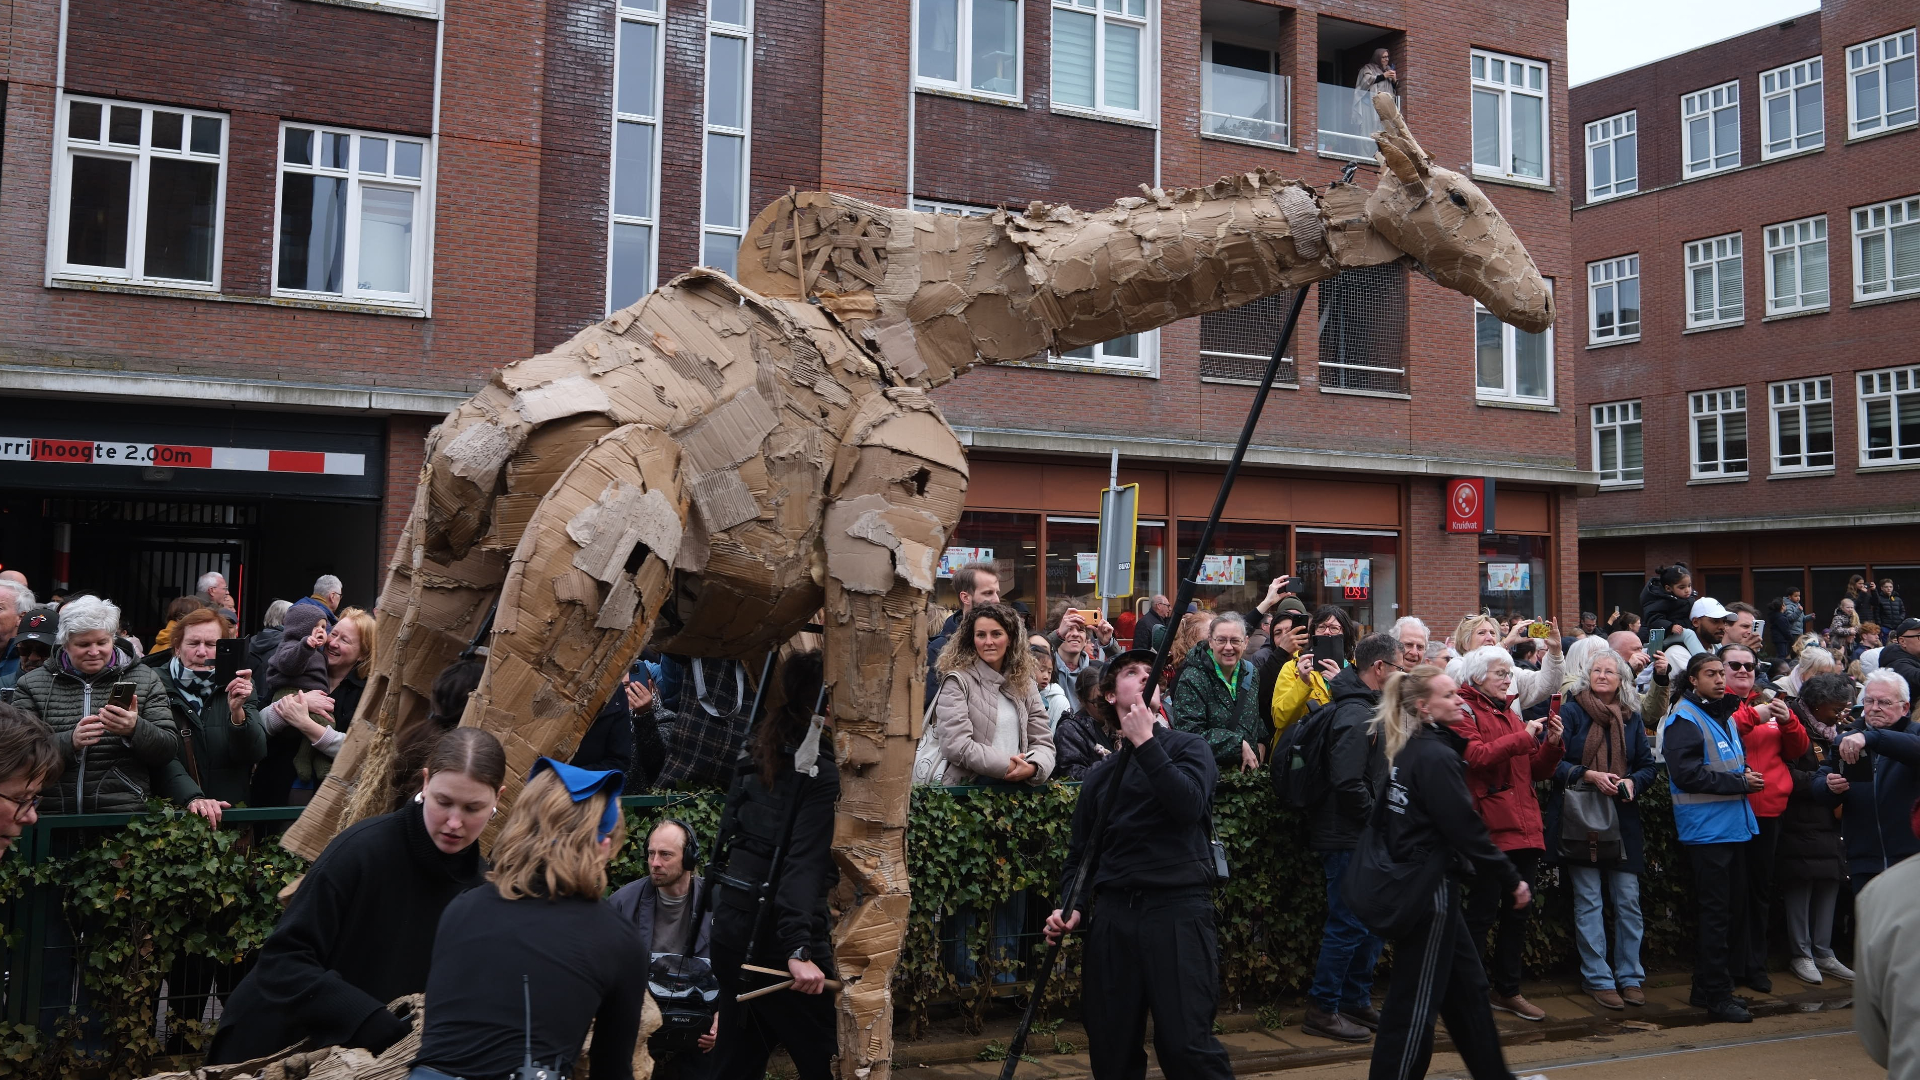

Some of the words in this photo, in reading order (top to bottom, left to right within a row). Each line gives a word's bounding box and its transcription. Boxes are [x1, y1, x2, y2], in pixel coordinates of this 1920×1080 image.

[0, 440, 117, 462] rrijhoogte
[125, 445, 192, 463] 2.00m
[1452, 521, 1477, 530] Kruidvat
